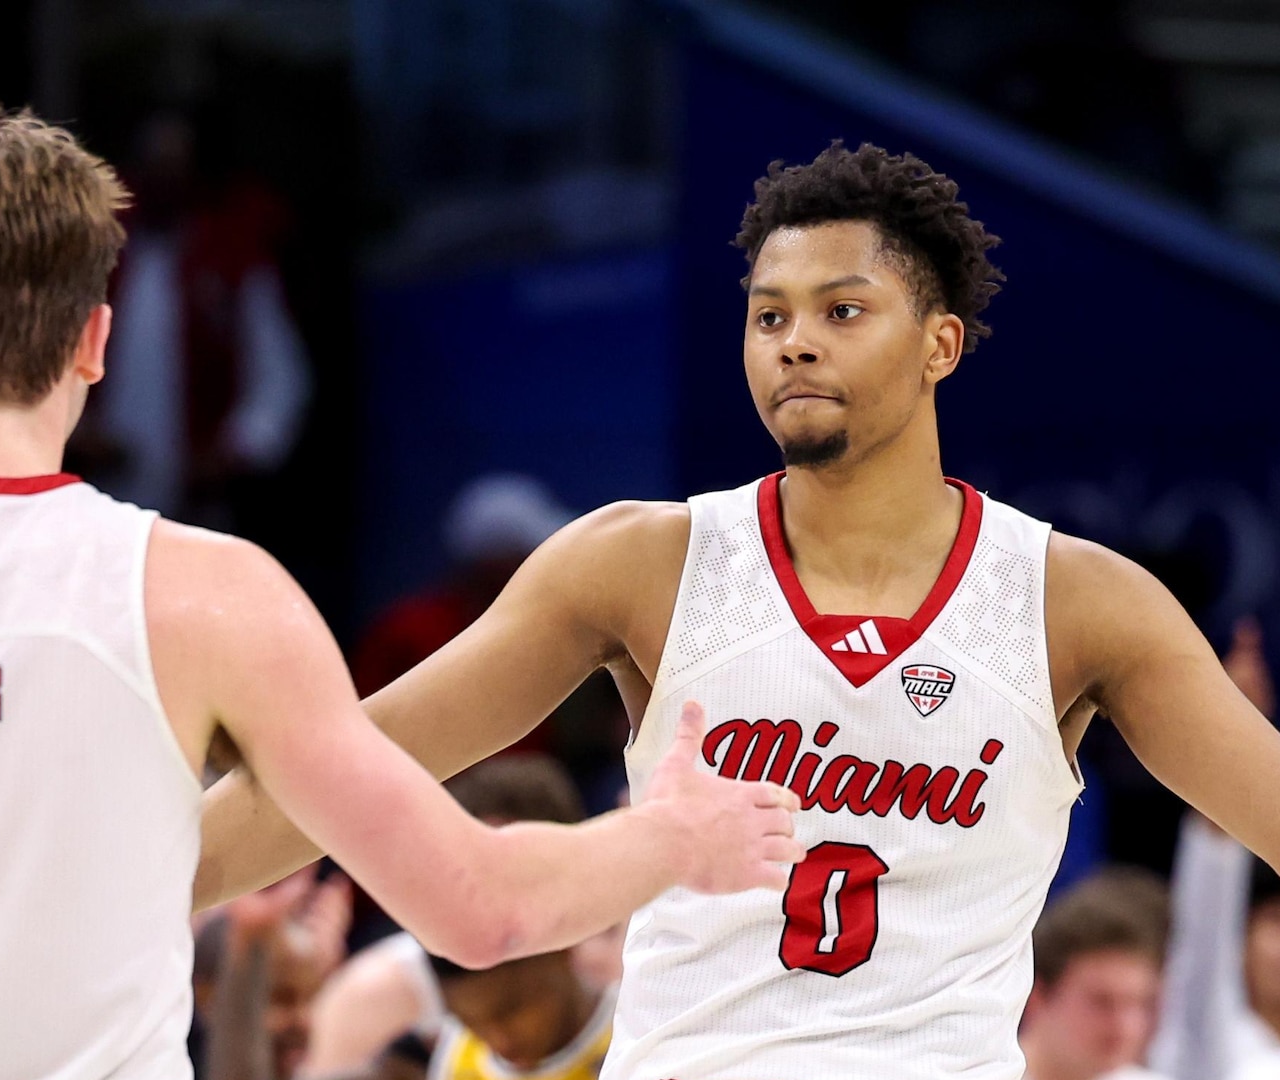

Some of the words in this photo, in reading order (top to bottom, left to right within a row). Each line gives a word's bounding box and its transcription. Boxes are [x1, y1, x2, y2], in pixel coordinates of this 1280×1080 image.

[903, 678, 952, 697] MAC
[702, 718, 1004, 828] Miami
[778, 840, 890, 978] 0
